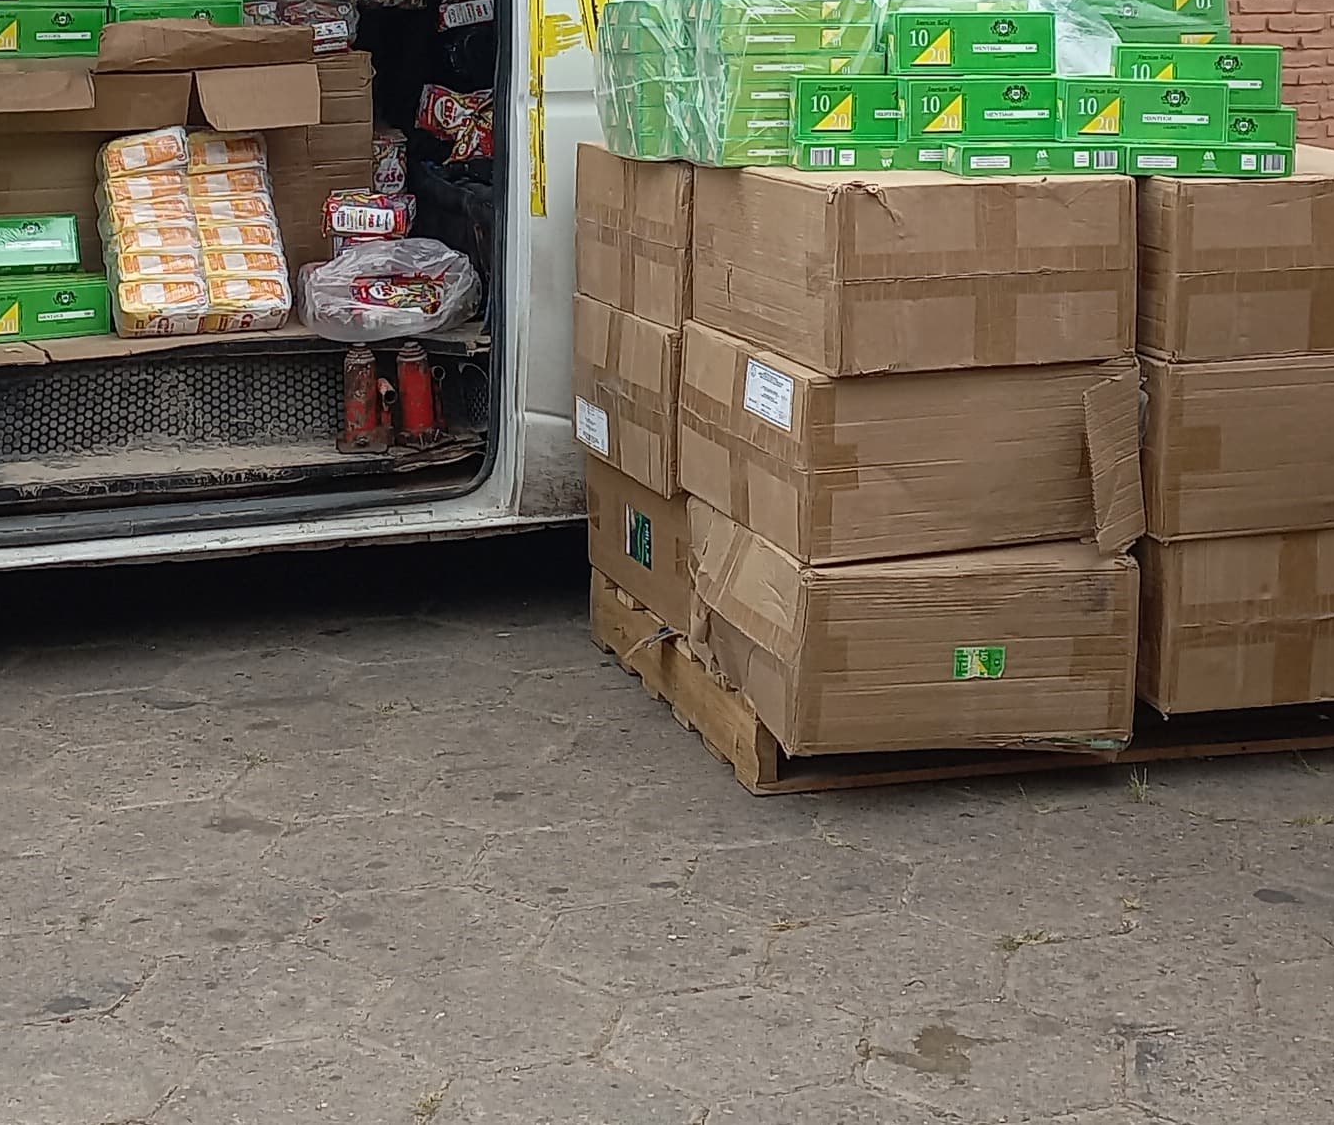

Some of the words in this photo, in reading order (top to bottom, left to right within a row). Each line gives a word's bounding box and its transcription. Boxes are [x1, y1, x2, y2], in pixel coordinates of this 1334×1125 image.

[909, 29, 929, 47] 10
[930, 48, 949, 62] 20
[1130, 63, 1151, 79] 10
[810, 95, 830, 113] 10
[921, 95, 940, 114] 10
[1077, 97, 1098, 115] 10
[830, 113, 849, 129] 20
[940, 114, 959, 130] 20
[1098, 116, 1117, 132] 20
[0, 318, 17, 332] 20
